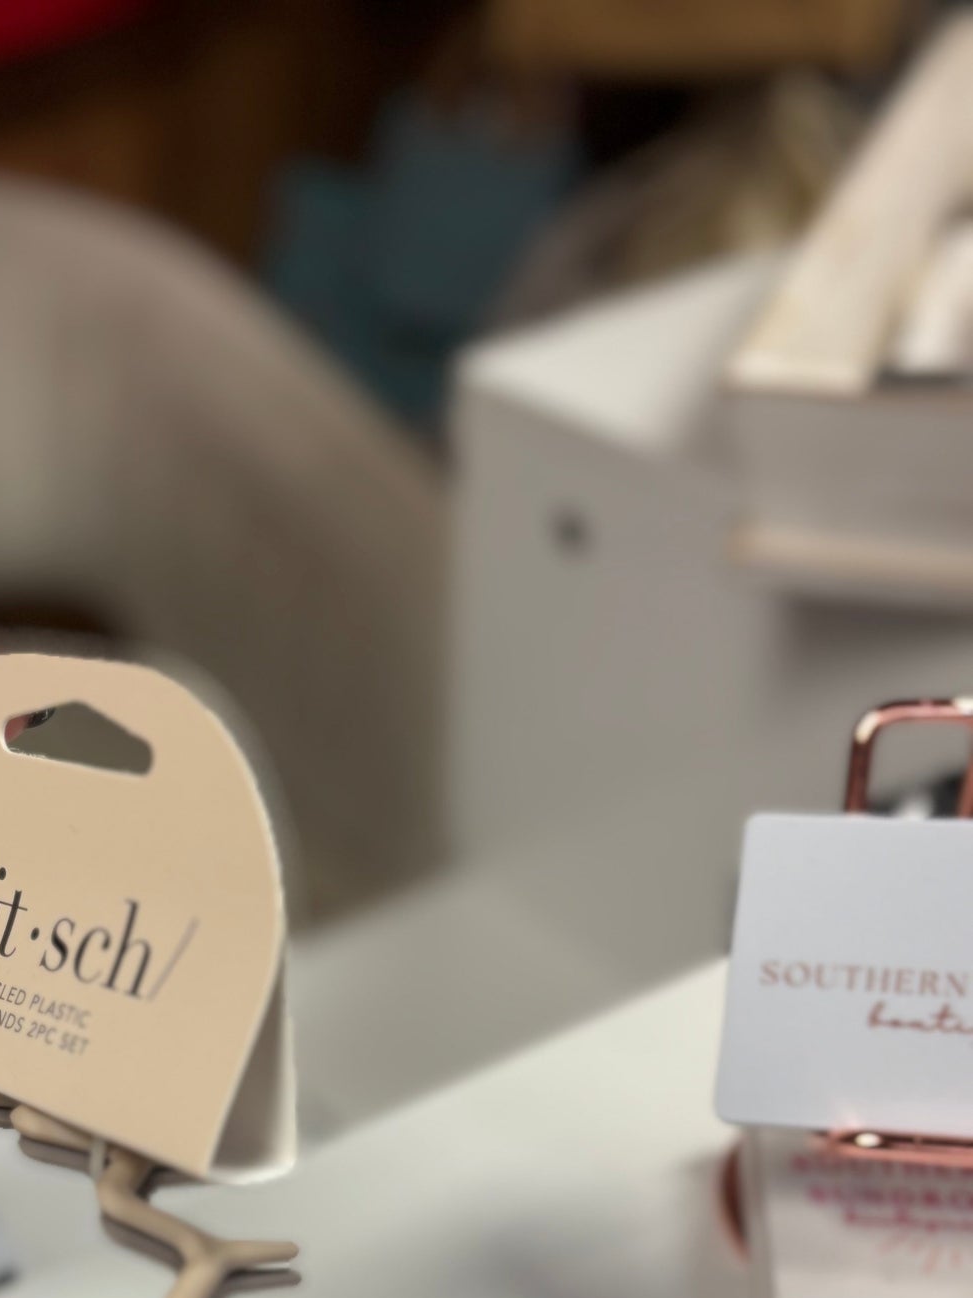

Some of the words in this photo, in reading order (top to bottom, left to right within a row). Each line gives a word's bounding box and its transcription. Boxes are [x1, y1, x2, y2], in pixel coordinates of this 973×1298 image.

[760, 959, 970, 998] SOUTHERN
[29, 994, 92, 1030] PLASTIC
[27, 1021, 57, 1045] 2PC
[58, 1031, 90, 1056] SET
